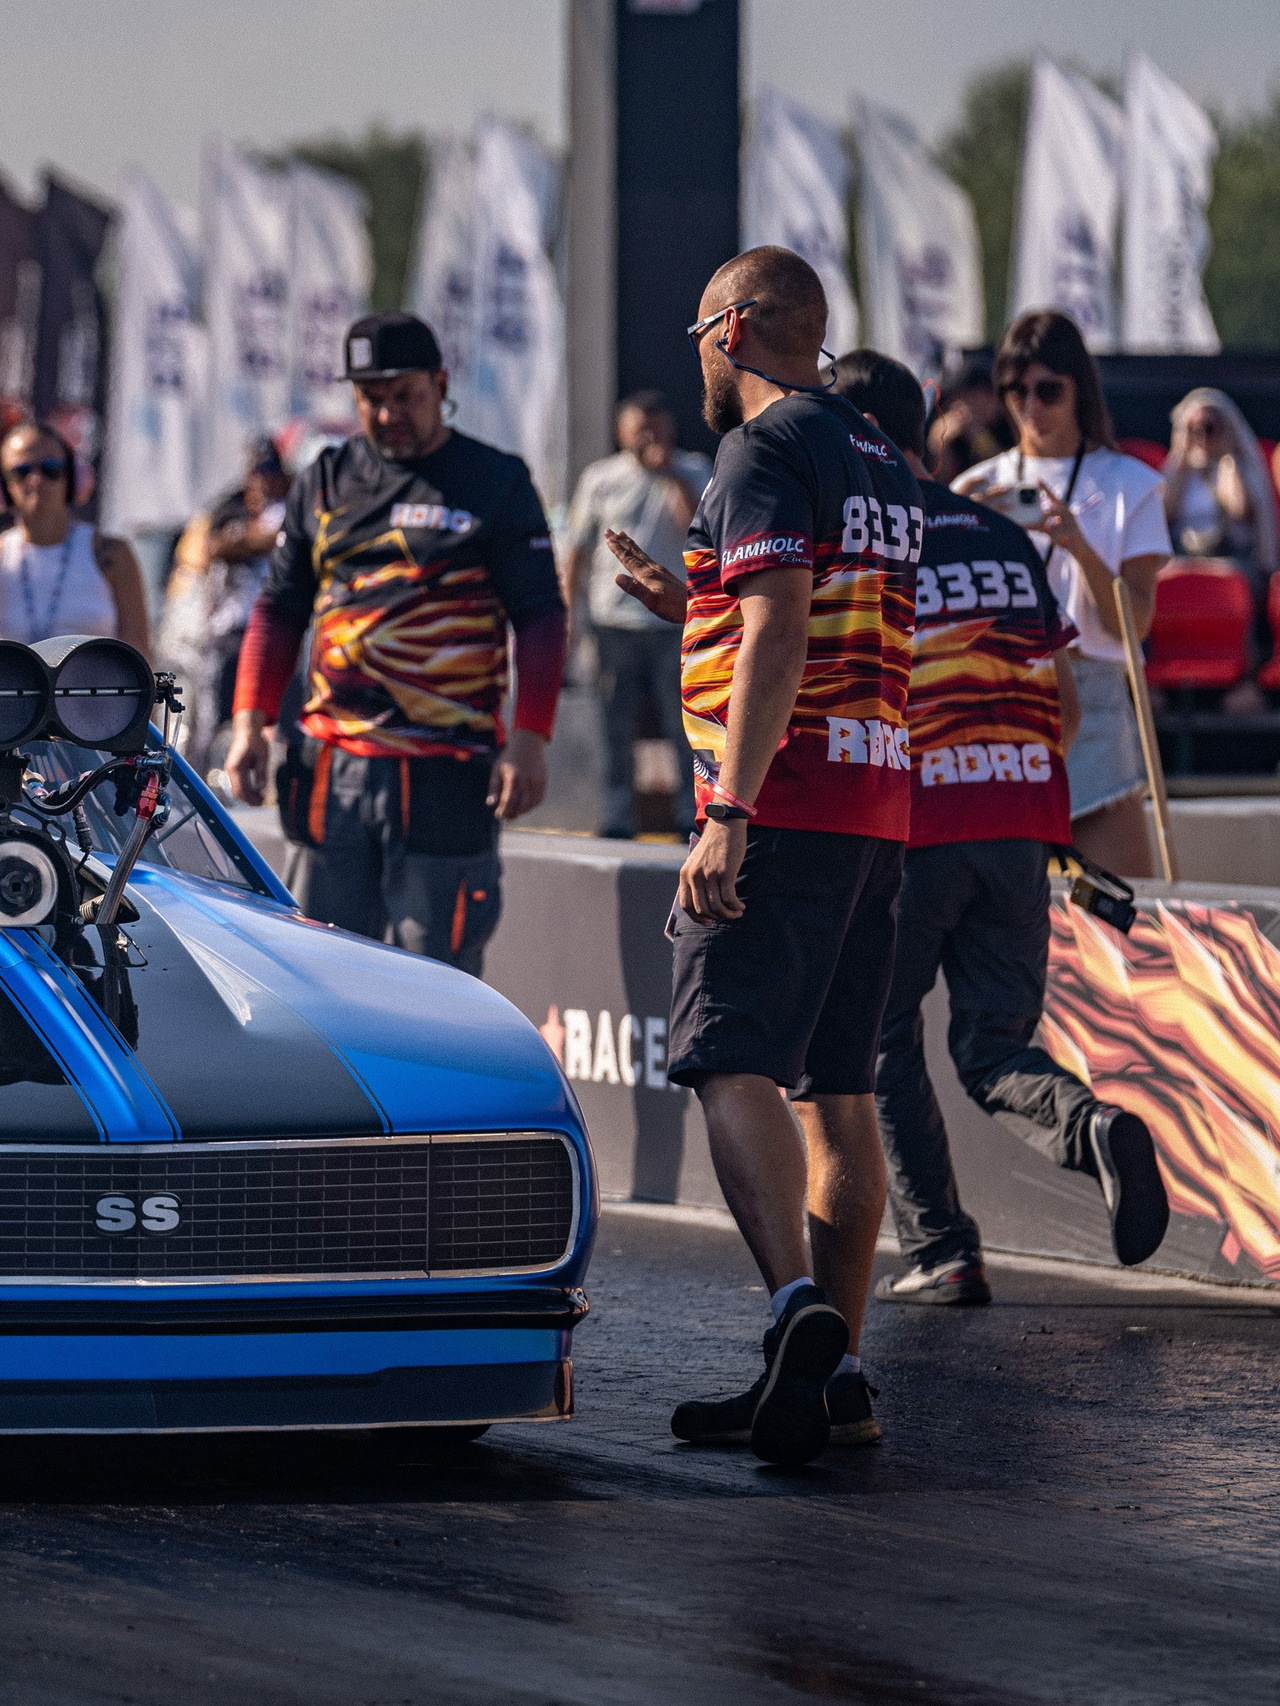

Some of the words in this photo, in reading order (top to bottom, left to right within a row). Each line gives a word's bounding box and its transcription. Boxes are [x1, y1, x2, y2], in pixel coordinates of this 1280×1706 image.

[721, 537, 805, 571] FLAMHOLC
[841, 495, 923, 564] 8333
[915, 560, 1038, 617] 8333
[921, 743, 1052, 787] RDRC
[563, 1008, 681, 1093] RACE
[95, 1196, 180, 1232] SS
